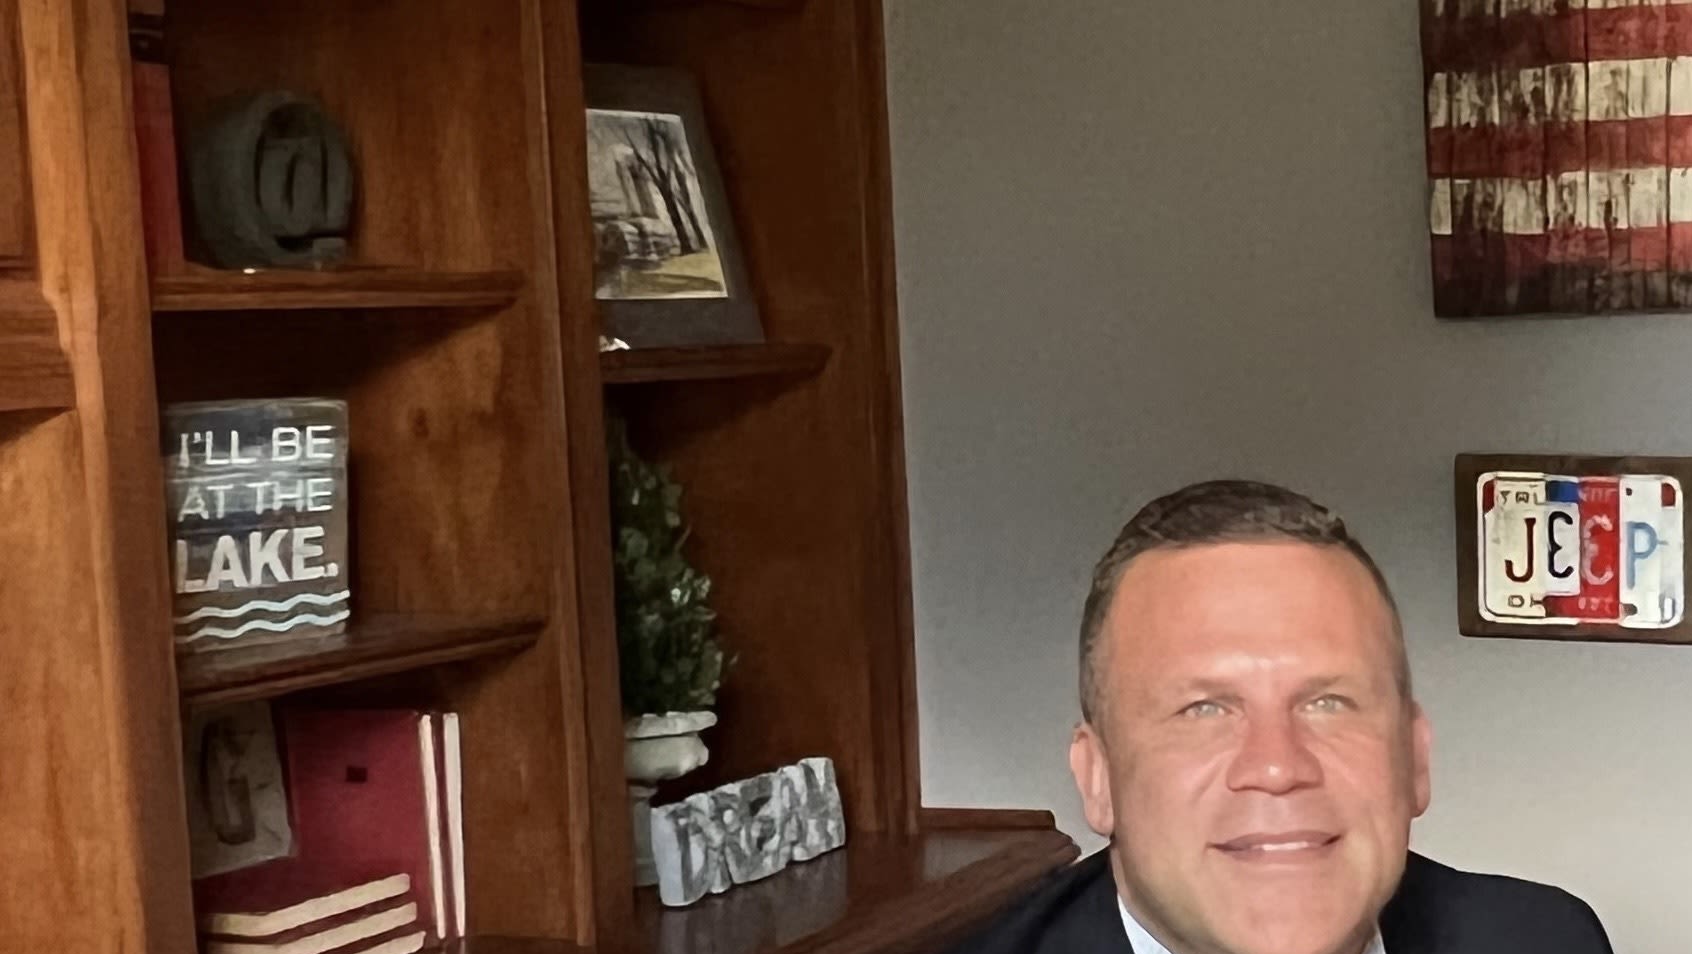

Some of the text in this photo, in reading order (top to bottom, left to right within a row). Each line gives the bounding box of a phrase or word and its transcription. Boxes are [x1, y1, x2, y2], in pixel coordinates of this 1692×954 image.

[179, 425, 334, 468] I'LL BE
[177, 478, 334, 522] AT THE
[175, 526, 339, 593] LAKE.
